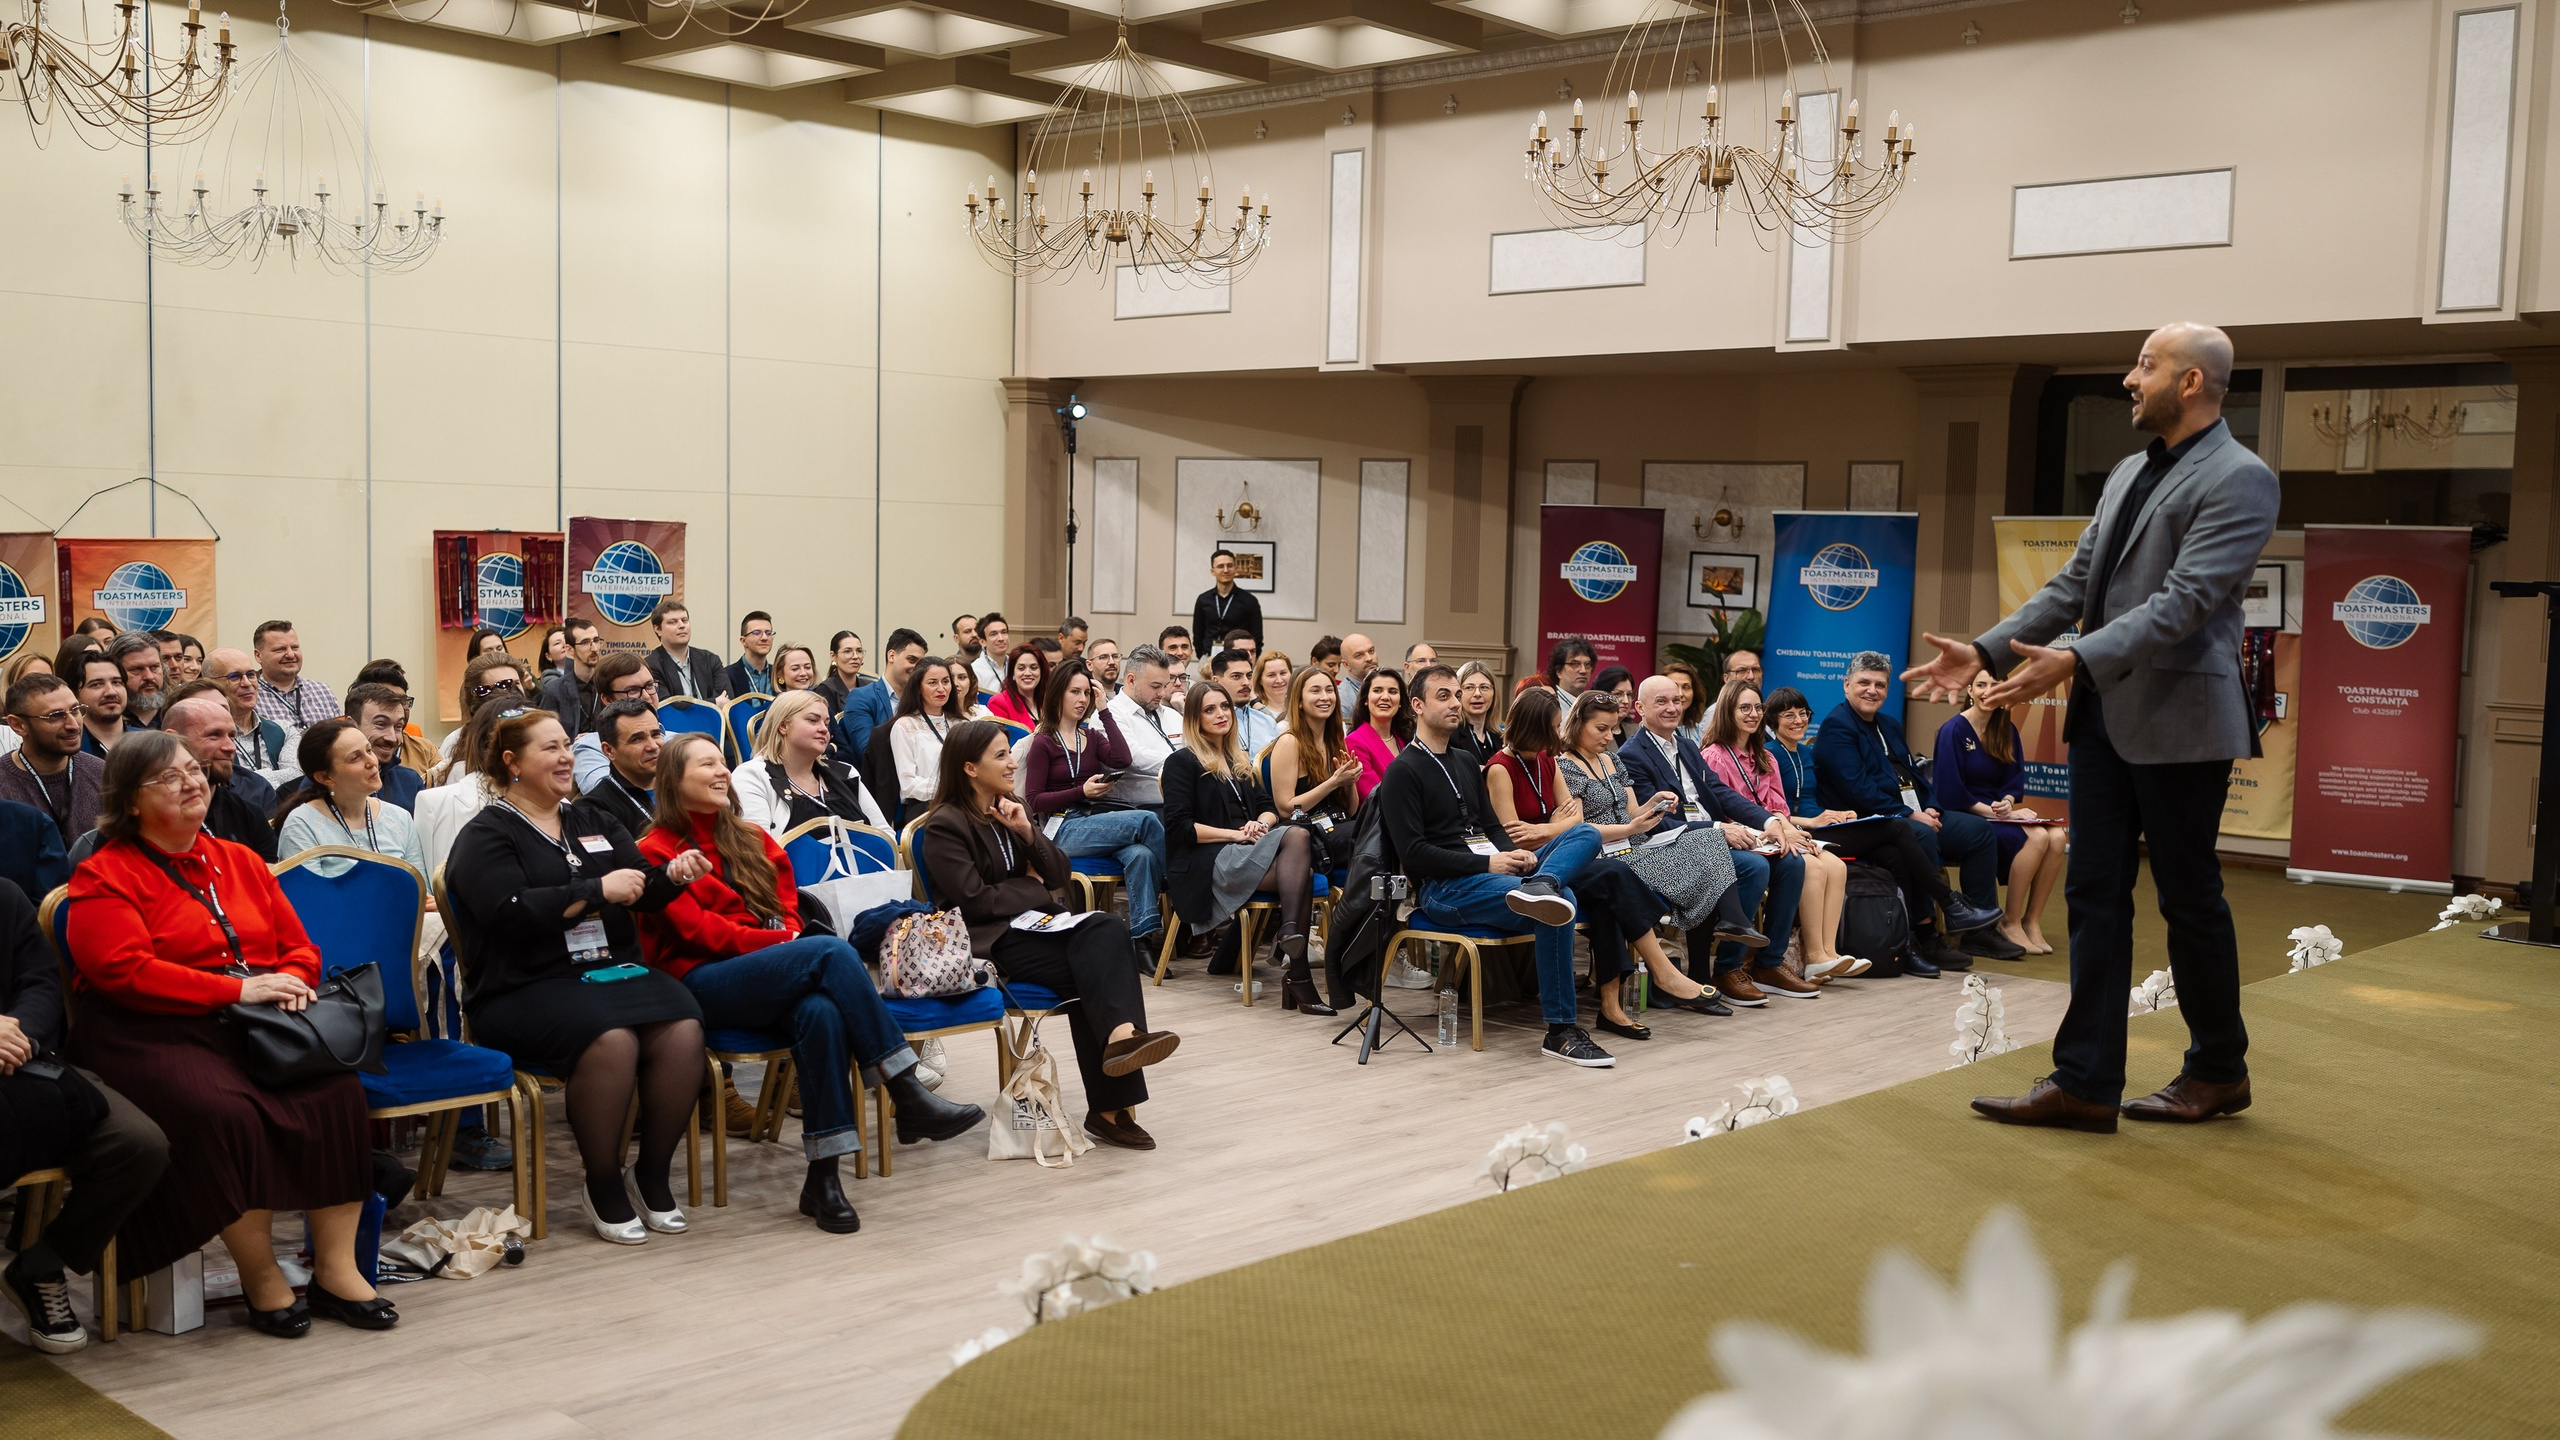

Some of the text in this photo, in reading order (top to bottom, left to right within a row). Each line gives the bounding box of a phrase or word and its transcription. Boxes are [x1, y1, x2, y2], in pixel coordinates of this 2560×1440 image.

[1564, 565, 1635, 574] TOASTMASTERS
[1803, 569, 1876, 579] TOASTMASTERS
[585, 573, 670, 585] TOASTMASTERS
[594, 584, 661, 592] INTERNATIONAL
[97, 591, 183, 600] TOASTMASTERS
[2336, 604, 2428, 615] TOASTMASTERS
[2345, 613, 2417, 621] INTERNATIONAL
[1583, 633, 1646, 643] TOASTMASTERS
[1797, 672, 1826, 680] Republic
[2337, 685, 2420, 698] TOASTMASTERS
[2352, 707, 2370, 715] Club
[2028, 776, 2044, 785] Club
[2331, 849, 2408, 862] www.toastmasters.org
